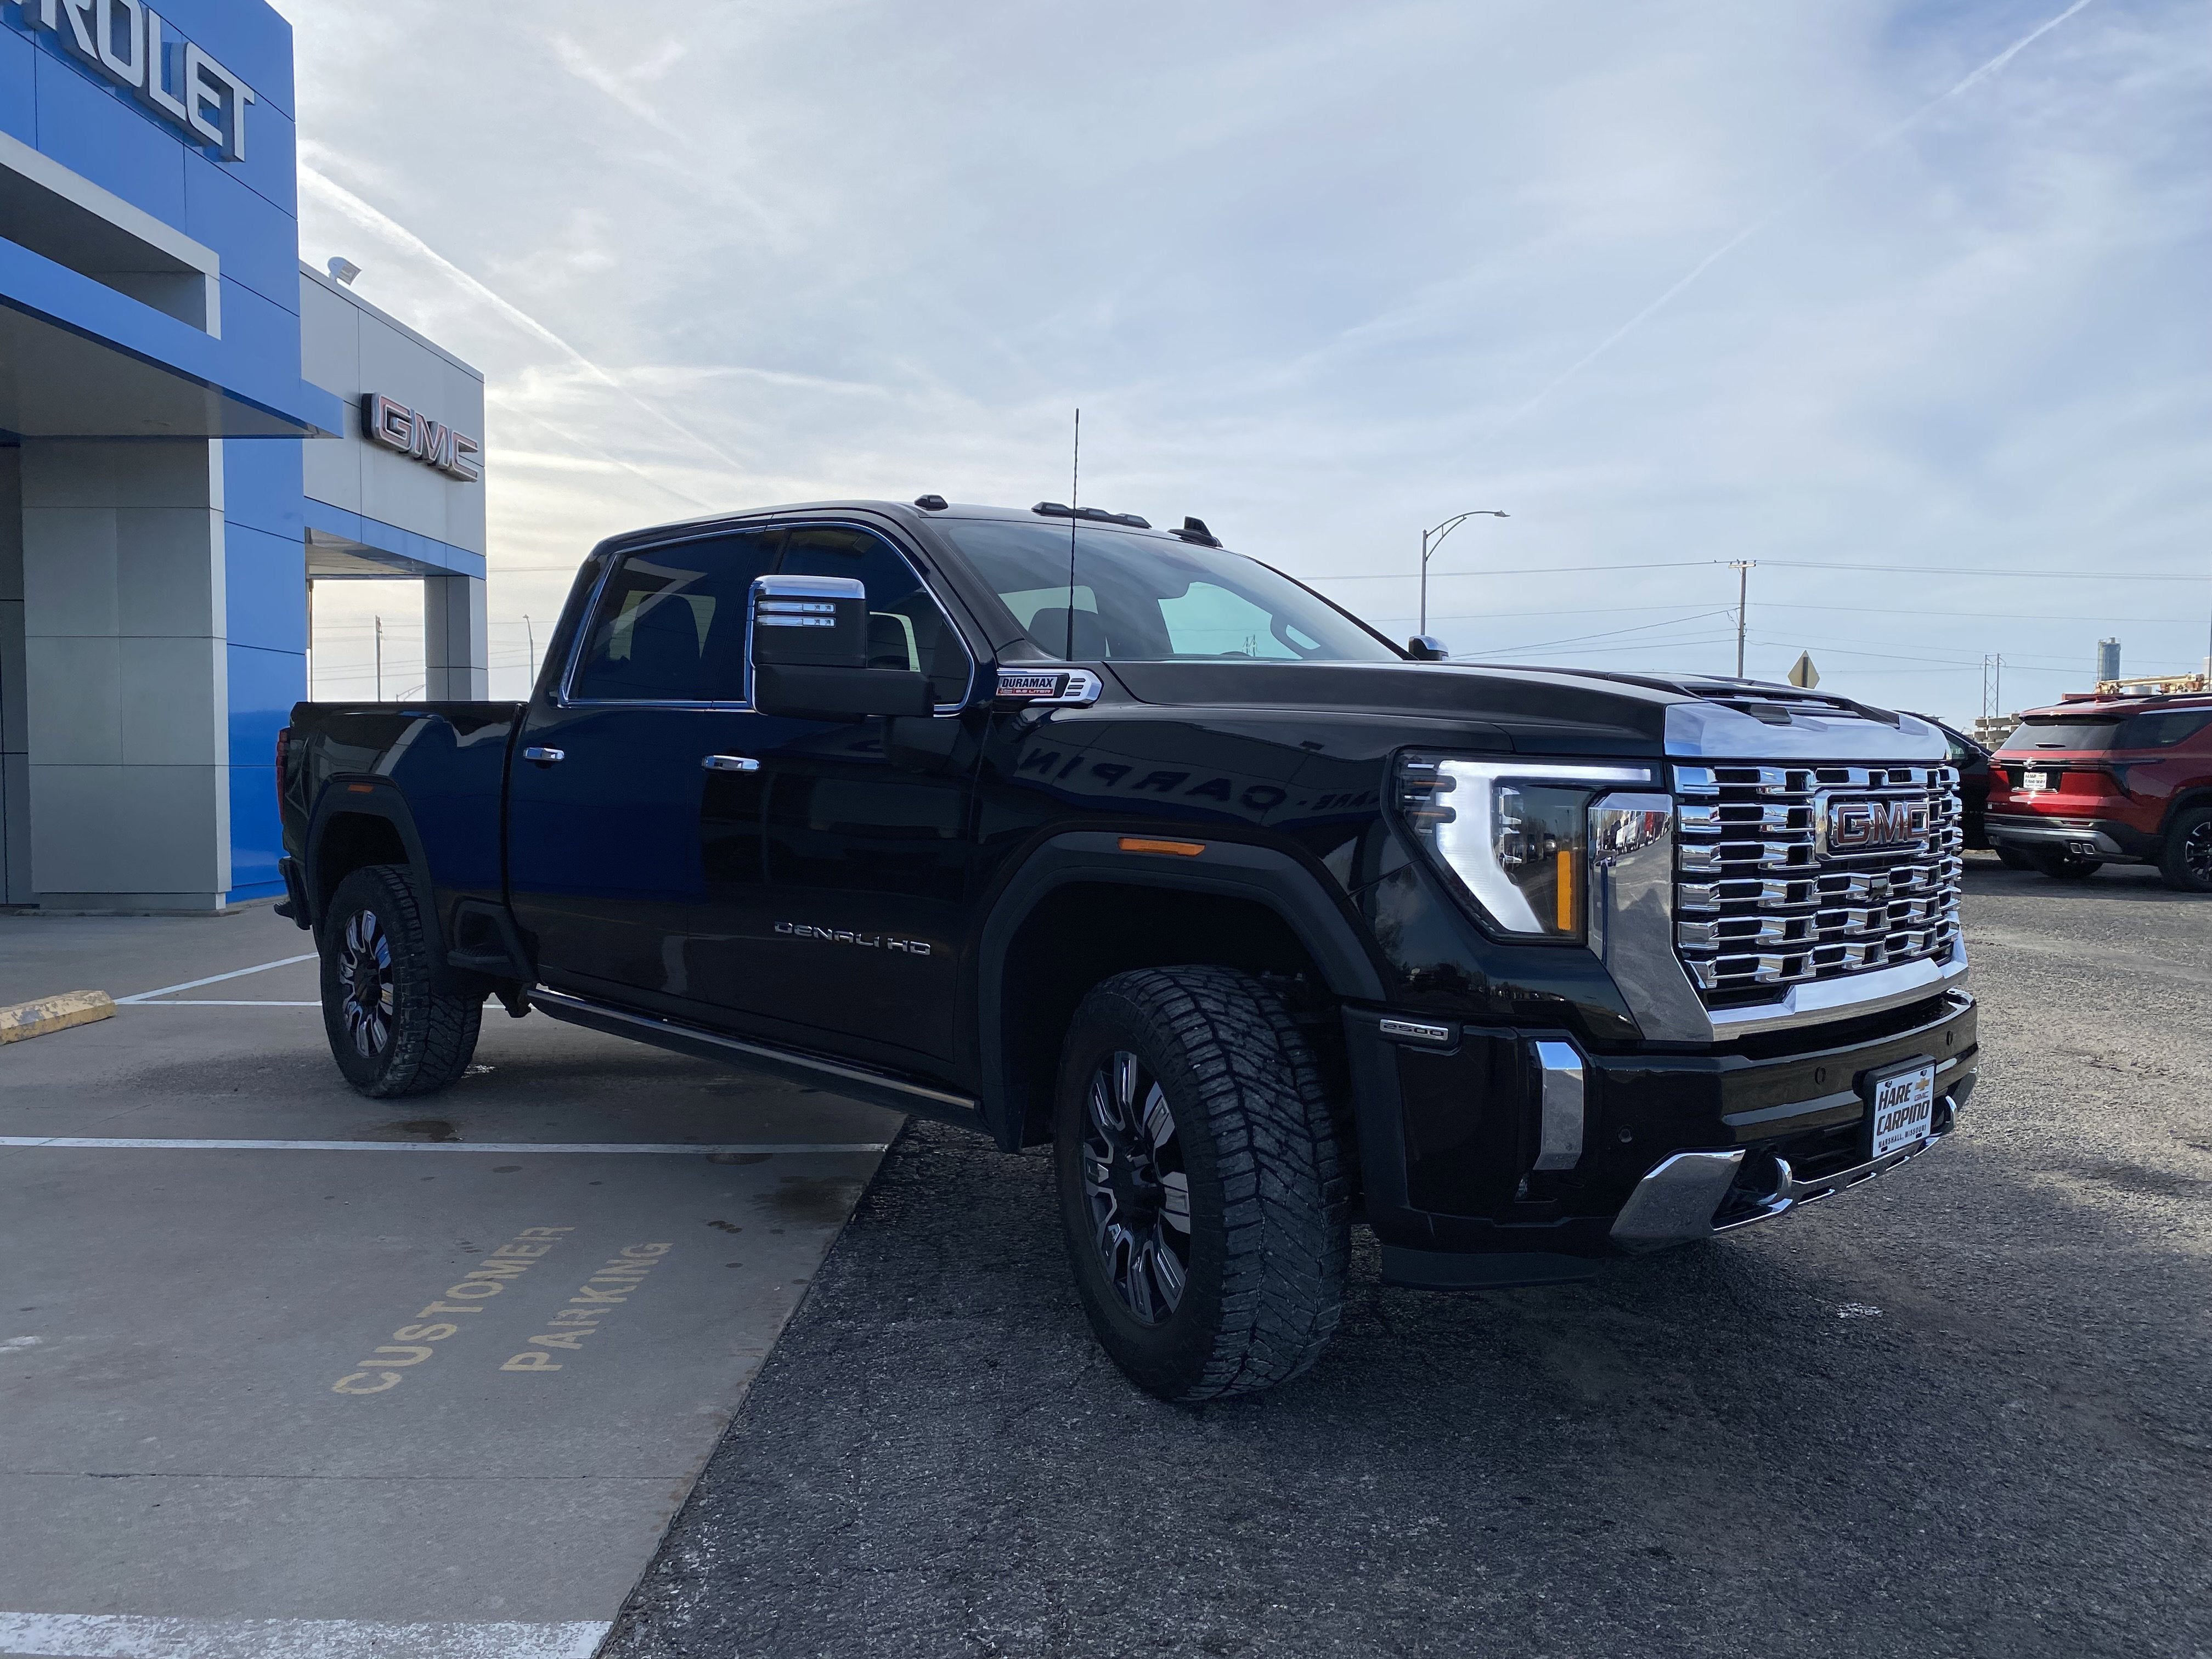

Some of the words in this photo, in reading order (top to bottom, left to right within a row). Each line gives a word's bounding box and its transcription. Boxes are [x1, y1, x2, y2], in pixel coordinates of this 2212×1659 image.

[9, 0, 256, 162] ROLET
[371, 393, 478, 482] GMC
[1002, 678, 1054, 688] DURAMAX
[1830, 802, 1929, 847] GMC
[774, 921, 879, 948] DENALI
[887, 937, 931, 956] HD
[1383, 1023, 1444, 1036] 2500
[1877, 1082, 1913, 1111] HARE
[1914, 1091, 1929, 1102] GMC
[1877, 1101, 1930, 1136] CARPINO
[1878, 1134, 1904, 1148] MARSHALL,
[1905, 1125, 1926, 1137] MISSOURI
[331, 1226, 576, 1395] CUSTOMER
[498, 1242, 674, 1372] PARKING
